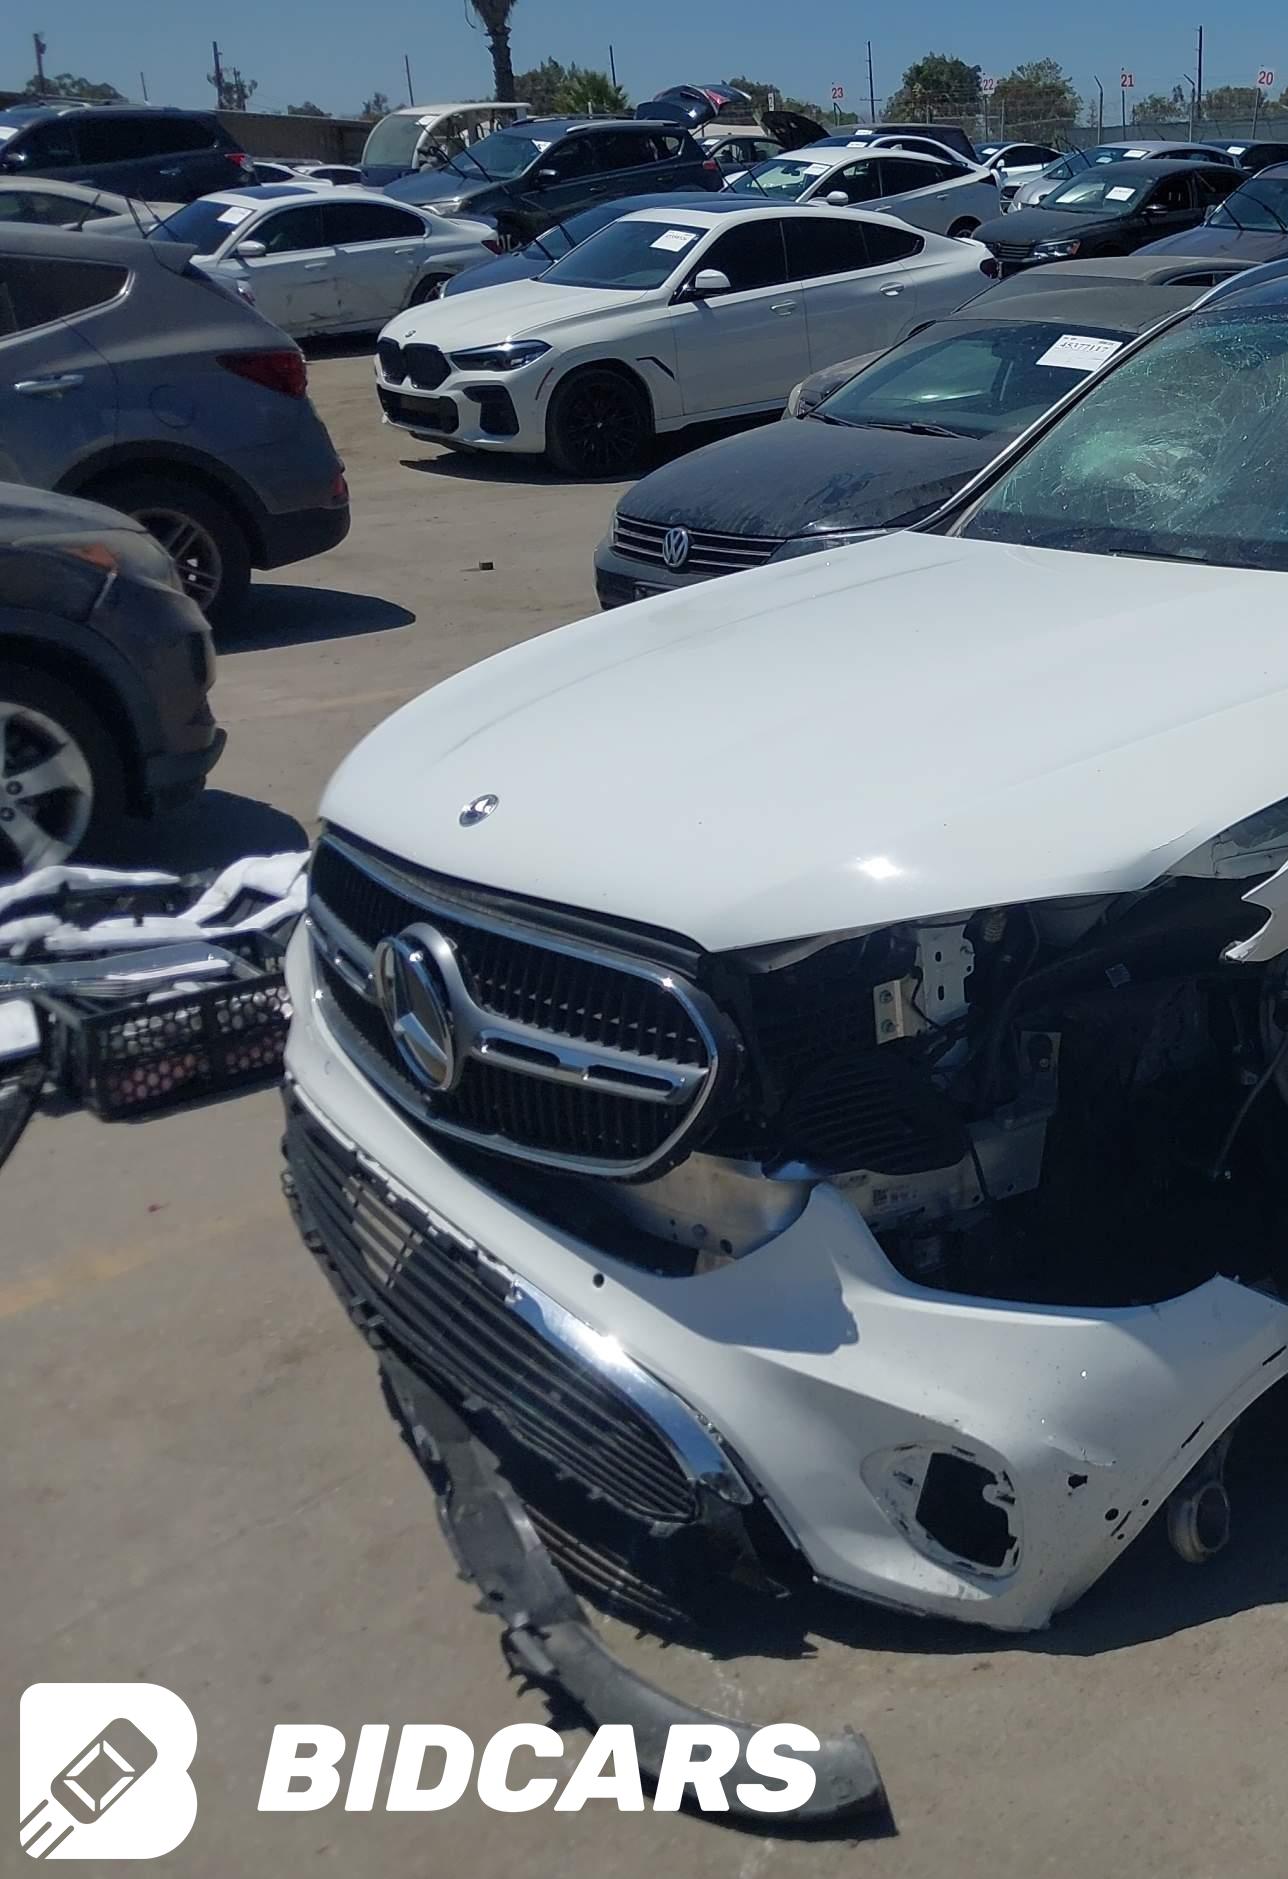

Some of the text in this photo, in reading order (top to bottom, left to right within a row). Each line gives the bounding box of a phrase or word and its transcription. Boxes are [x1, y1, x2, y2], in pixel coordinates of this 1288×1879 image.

[983, 78, 995, 91] 22
[1120, 73, 1135, 88] 21
[1258, 70, 1274, 86] 20
[831, 87, 844, 99] 23
